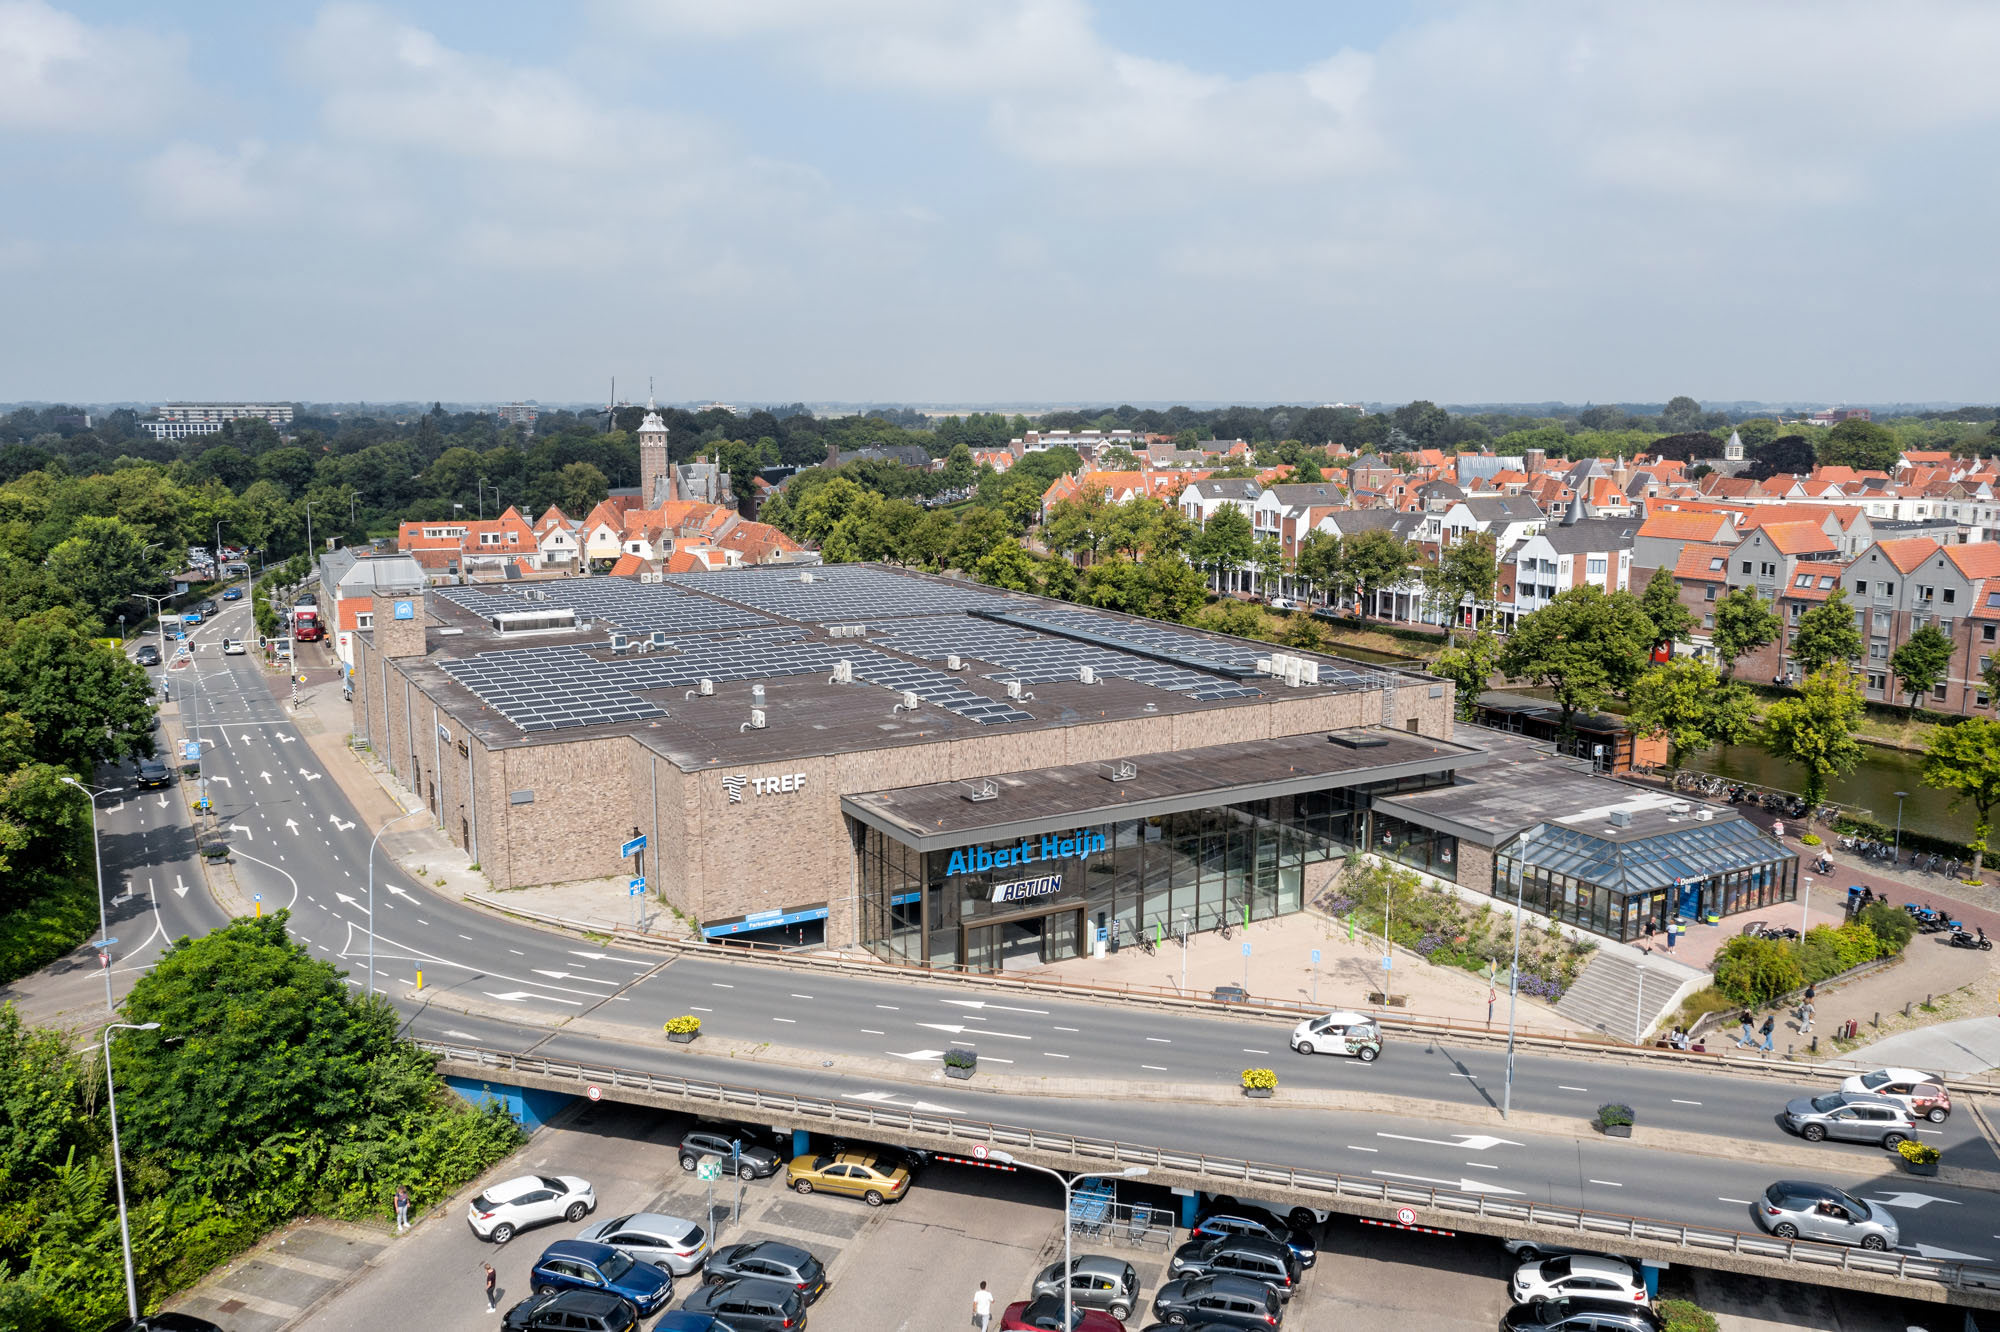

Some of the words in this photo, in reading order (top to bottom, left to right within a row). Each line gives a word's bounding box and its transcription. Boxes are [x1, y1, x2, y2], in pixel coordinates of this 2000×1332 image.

[752, 773, 806, 796] TREF
[946, 841, 1032, 876] Albert
[1041, 830, 1106, 861] Heijn
[1002, 875, 1062, 902] ACTION
